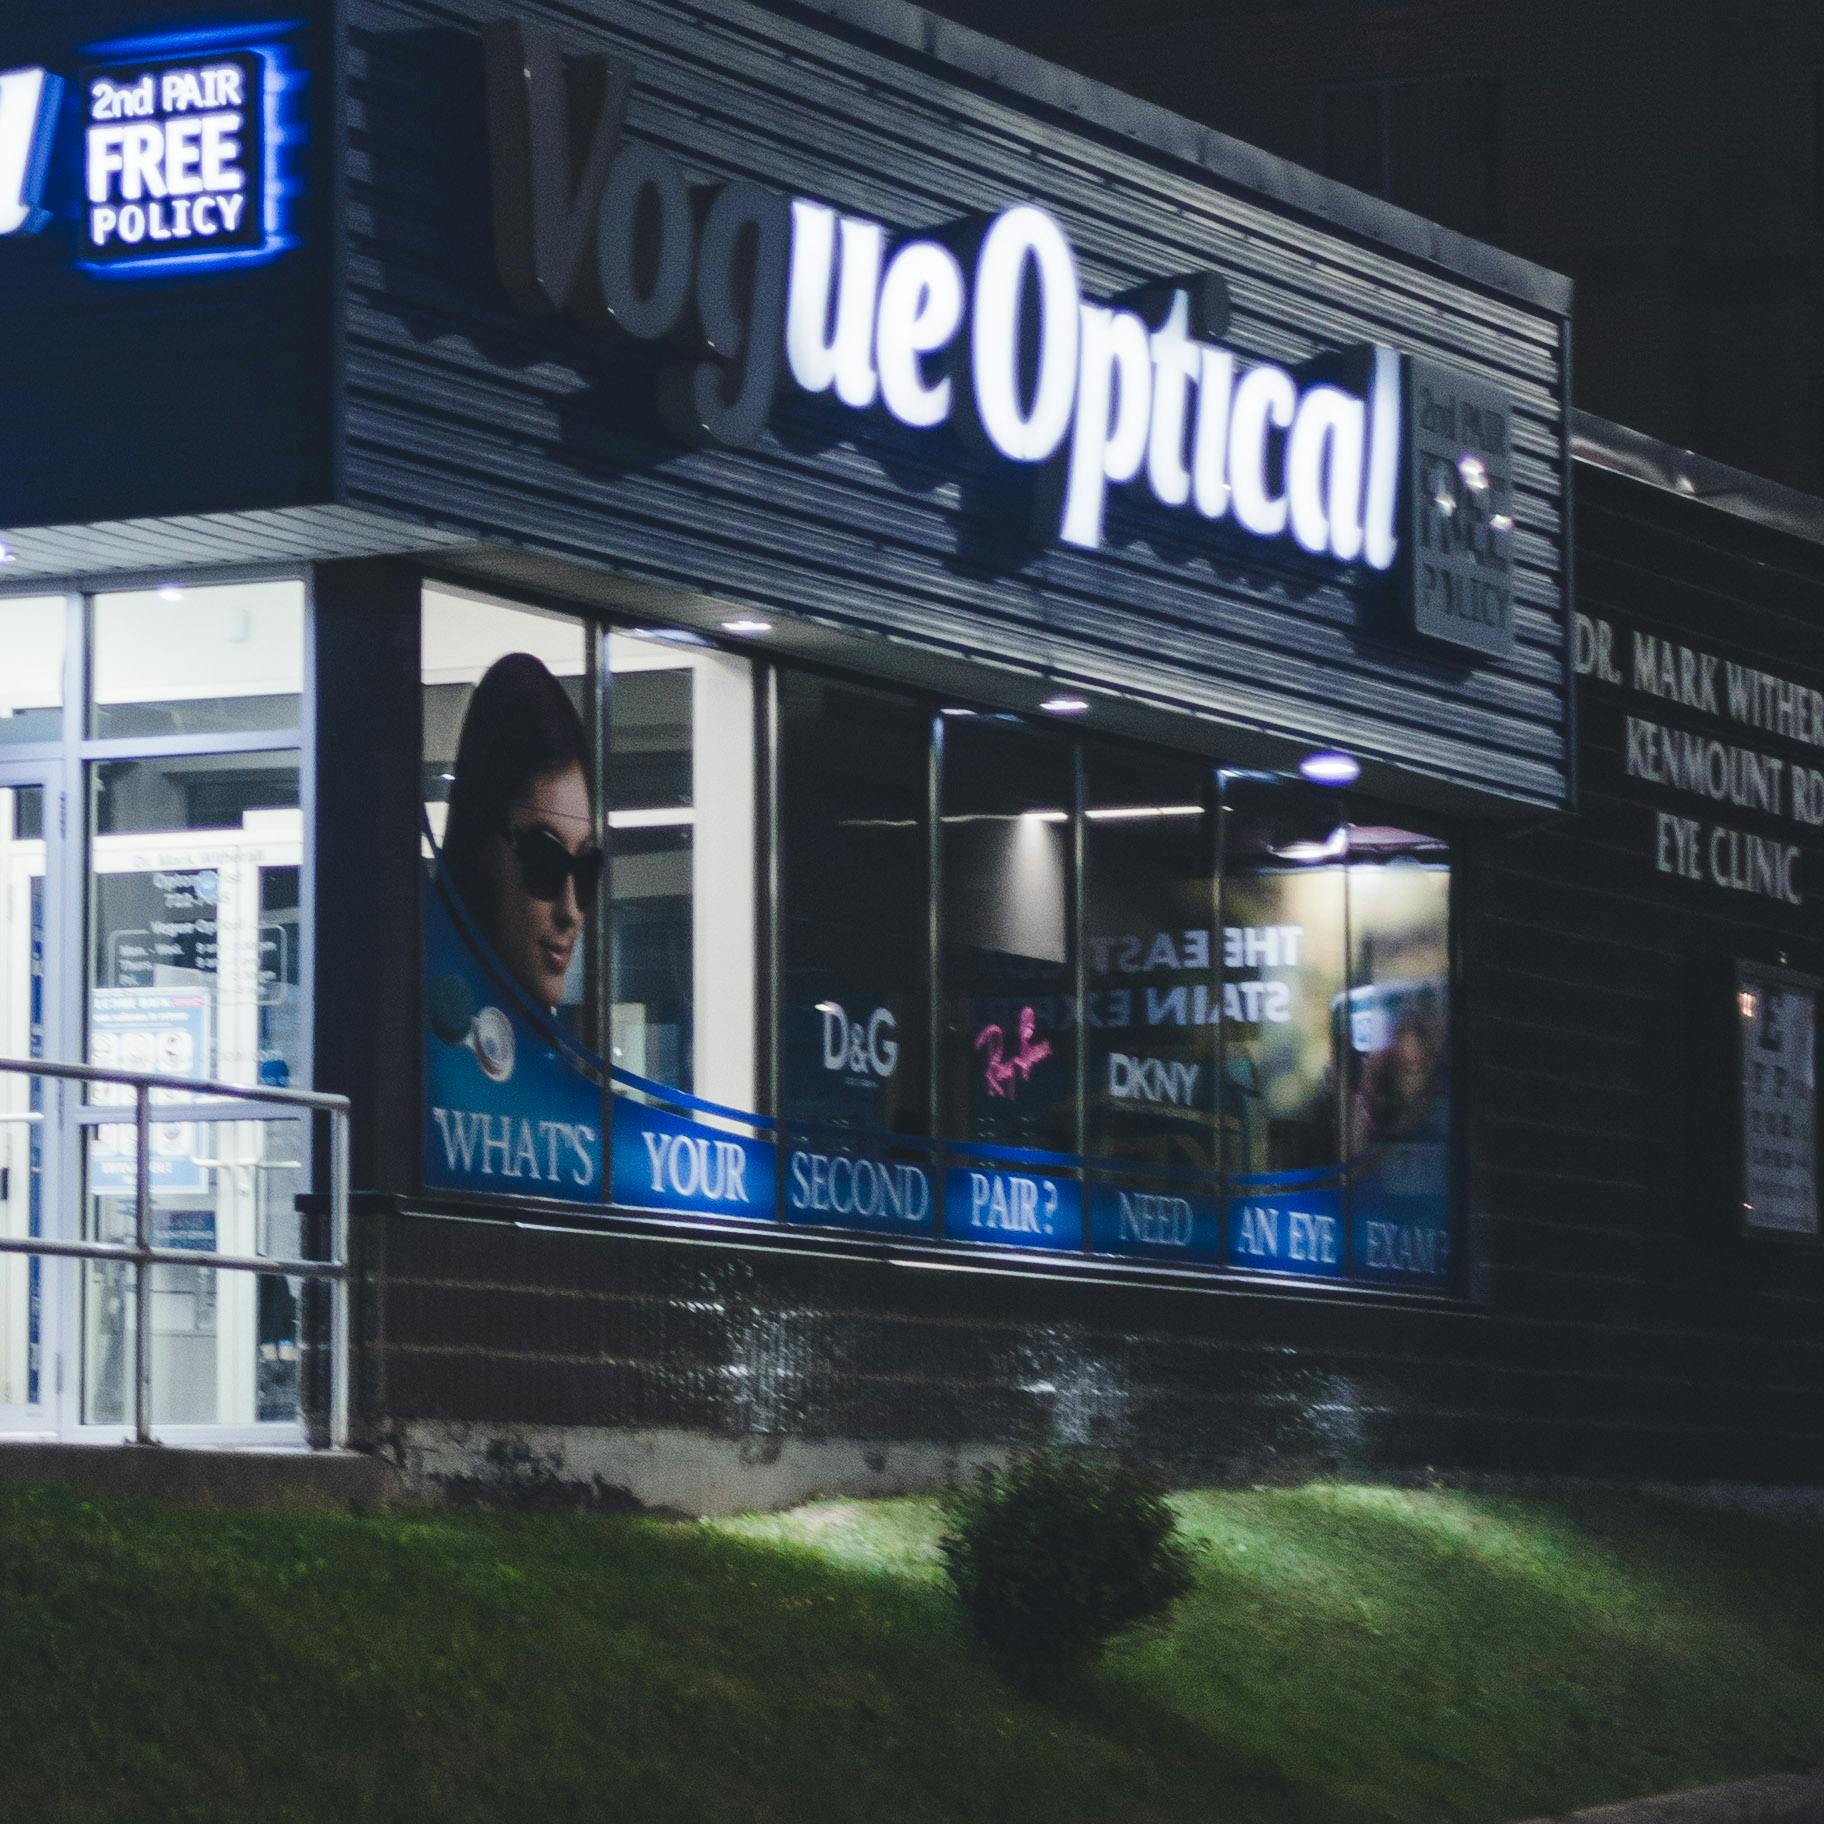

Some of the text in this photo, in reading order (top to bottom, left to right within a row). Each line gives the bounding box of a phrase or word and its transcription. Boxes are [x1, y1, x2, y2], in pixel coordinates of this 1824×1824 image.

[91, 68, 243, 120] 2nd PAIR
[87, 114, 243, 203] FREE
[92, 193, 244, 246] POLICY
[518, 28, 1401, 570] Vogue Optical
[1572, 611, 1623, 686] DR.
[1632, 630, 1720, 716] MARK
[1626, 715, 1784, 816] KENMOUNT
[1657, 812, 1802, 905] EYE CLINIC
[819, 1004, 900, 1078] D&G
[1108, 1051, 1201, 1107] DKNY
[434, 1107, 597, 1186] WHAT'S
[642, 1131, 750, 1202] YOUR
[791, 1150, 930, 1222] SECOND
[970, 1172, 1059, 1236] PAIR?
[1118, 1192, 1194, 1247] NEED
[1238, 1207, 1280, 1257] AN
[1289, 1212, 1337, 1264] EYE
